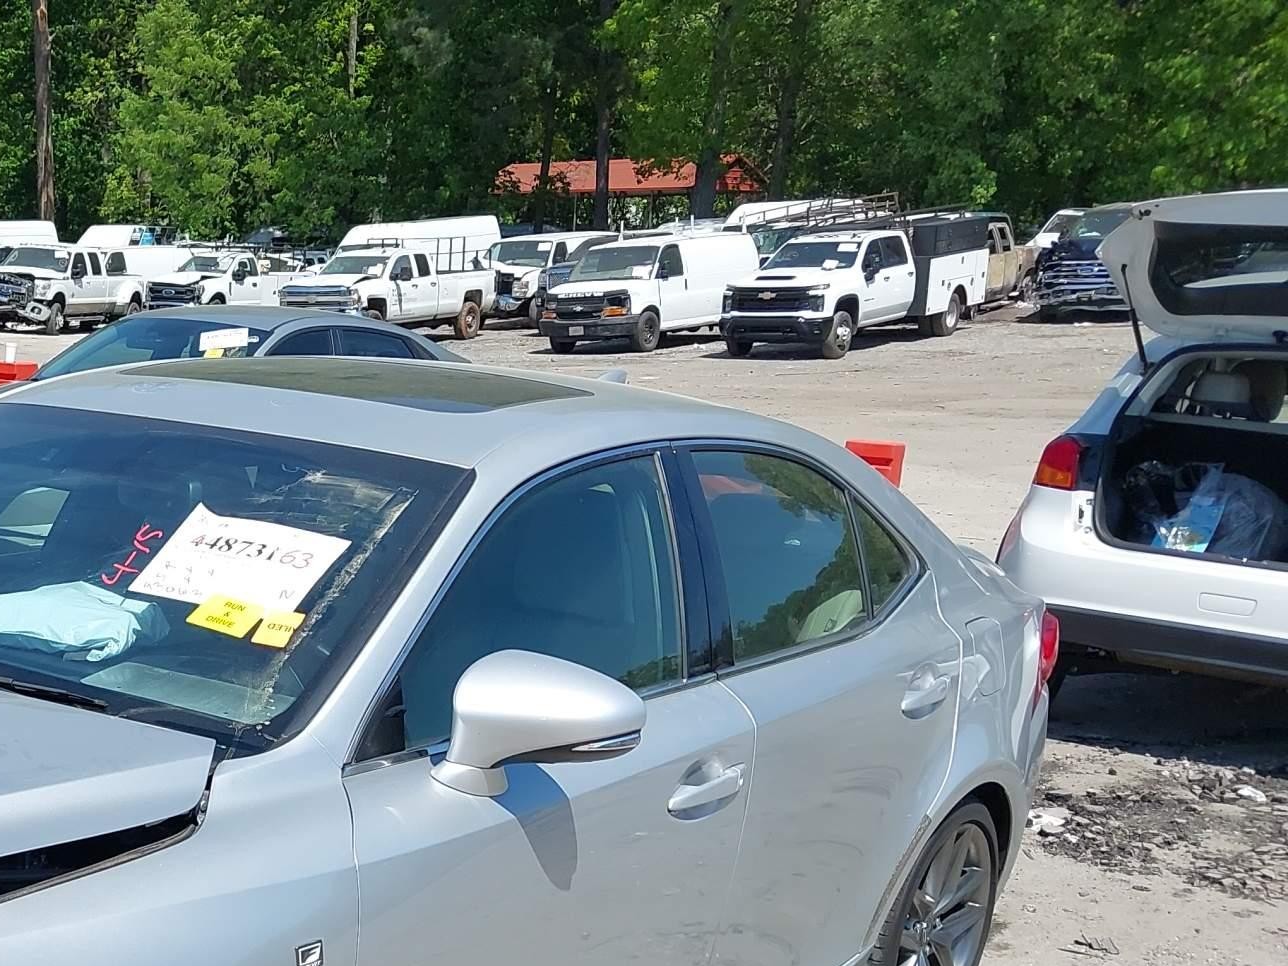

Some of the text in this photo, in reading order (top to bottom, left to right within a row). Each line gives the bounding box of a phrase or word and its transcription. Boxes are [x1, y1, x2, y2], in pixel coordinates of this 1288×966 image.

[190, 534, 314, 569] 44873163
[223, 601, 247, 612] RUN
[205, 615, 236, 629] DRIVE
